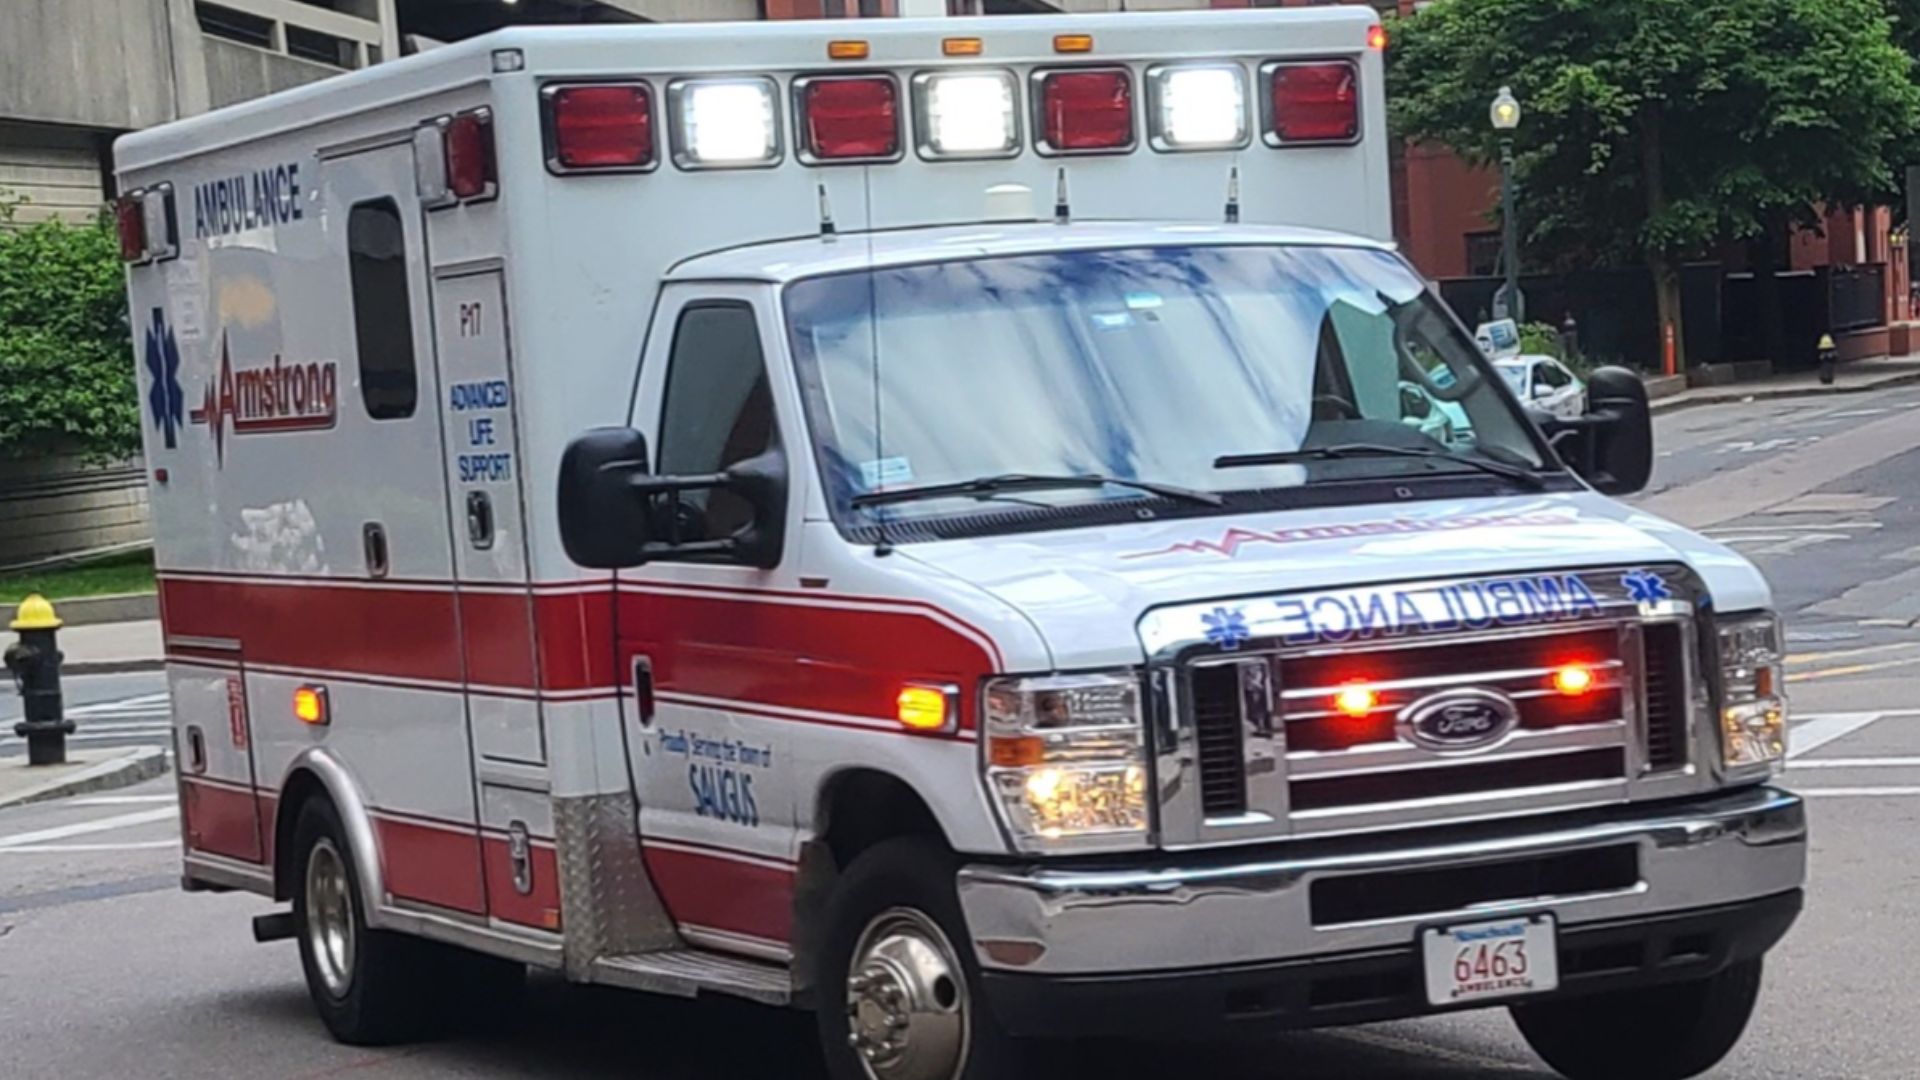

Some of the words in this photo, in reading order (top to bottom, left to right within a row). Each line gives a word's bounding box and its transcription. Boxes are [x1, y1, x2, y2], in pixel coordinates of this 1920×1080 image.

[195, 163, 302, 240] AMBULANCE
[213, 328, 336, 432] Armstrong
[450, 381, 508, 410] ADVANCED
[469, 418, 495, 445] LIFE
[459, 453, 511, 482] SUPPORT
[1437, 704, 1493, 734] Ford
[689, 764, 759, 826] SAUGUS
[1454, 939, 1528, 983] 6463
